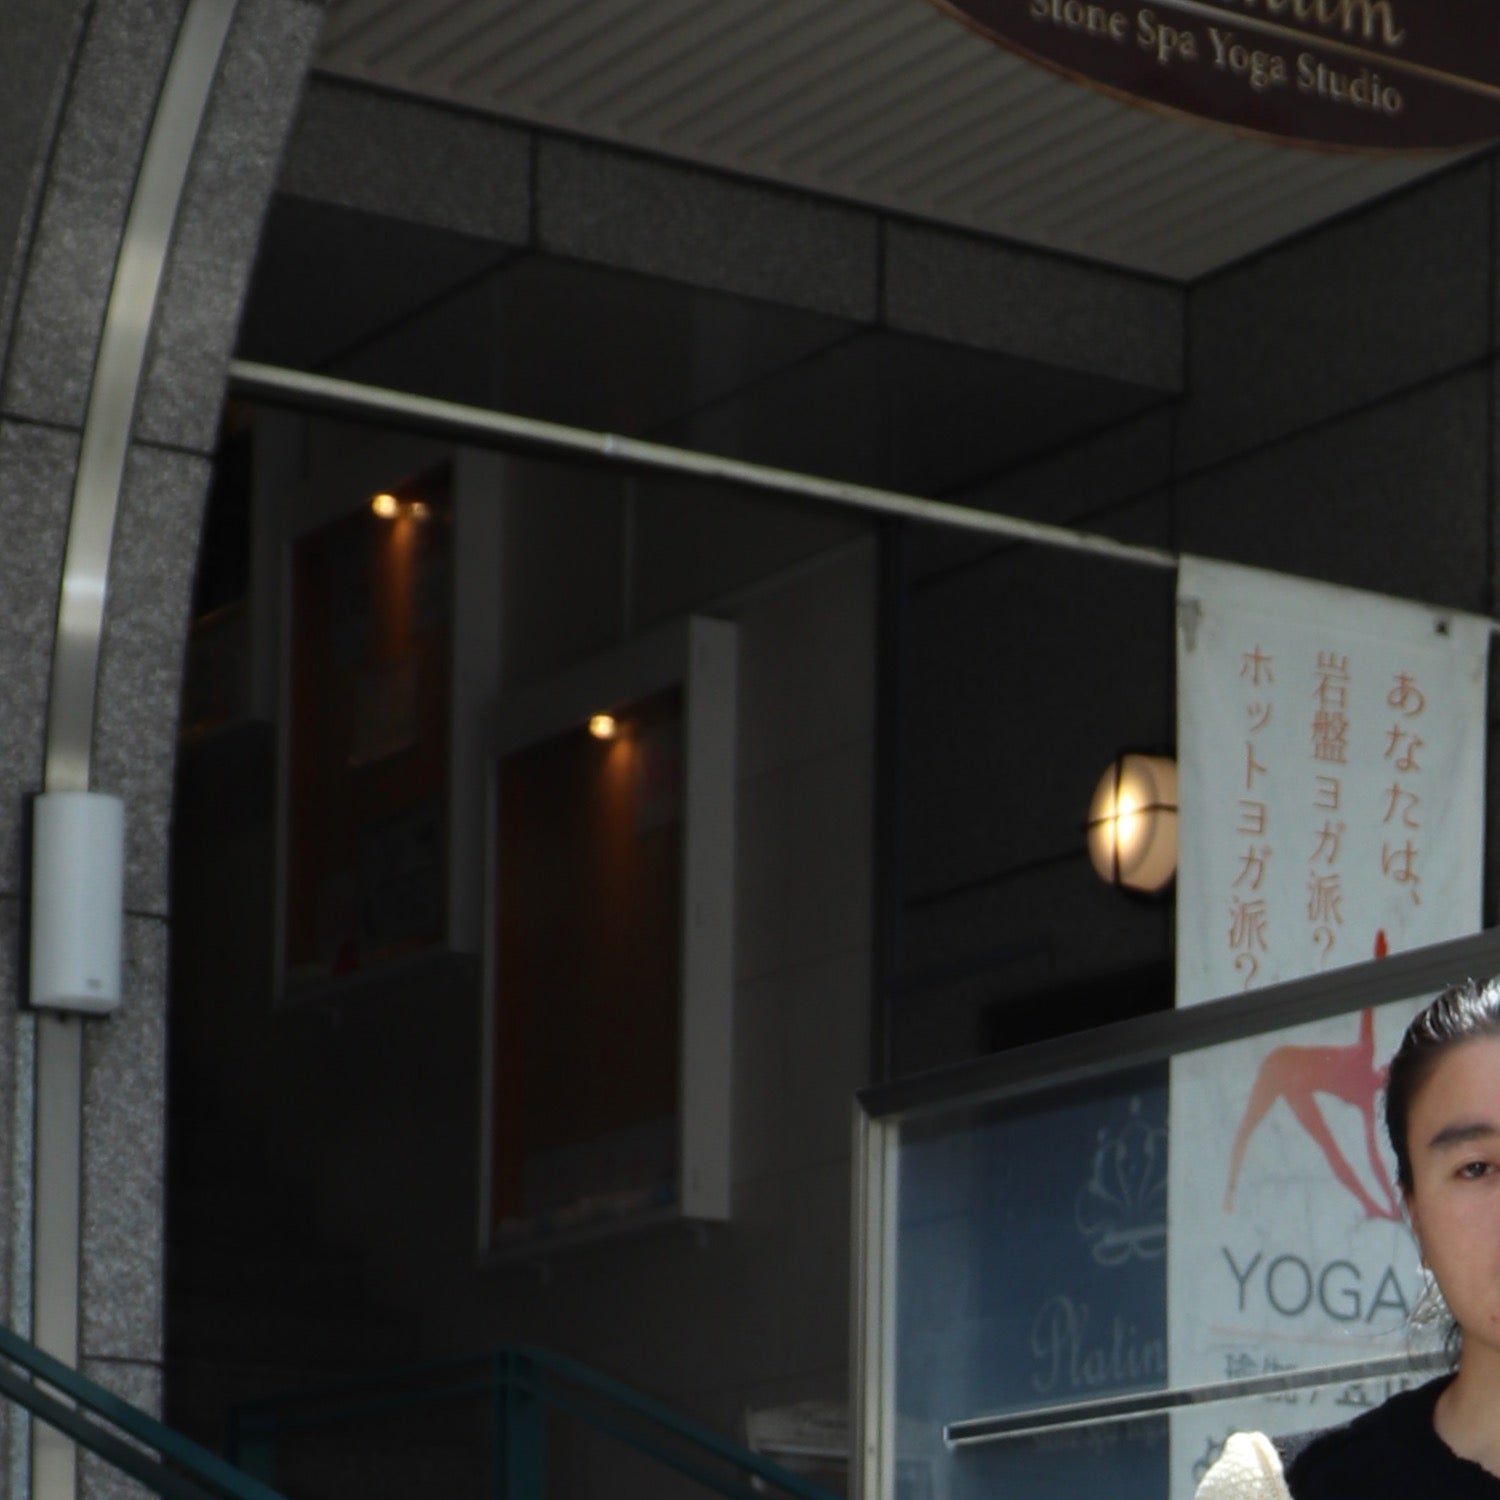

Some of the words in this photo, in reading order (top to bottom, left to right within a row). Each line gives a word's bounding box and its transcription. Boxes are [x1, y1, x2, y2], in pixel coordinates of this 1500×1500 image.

[1135, 8, 1197, 65] Spa
[1207, 26, 1288, 91] Yoga
[1295, 51, 1404, 113] Studio
[1220, 1245, 1411, 1325] YOGA
